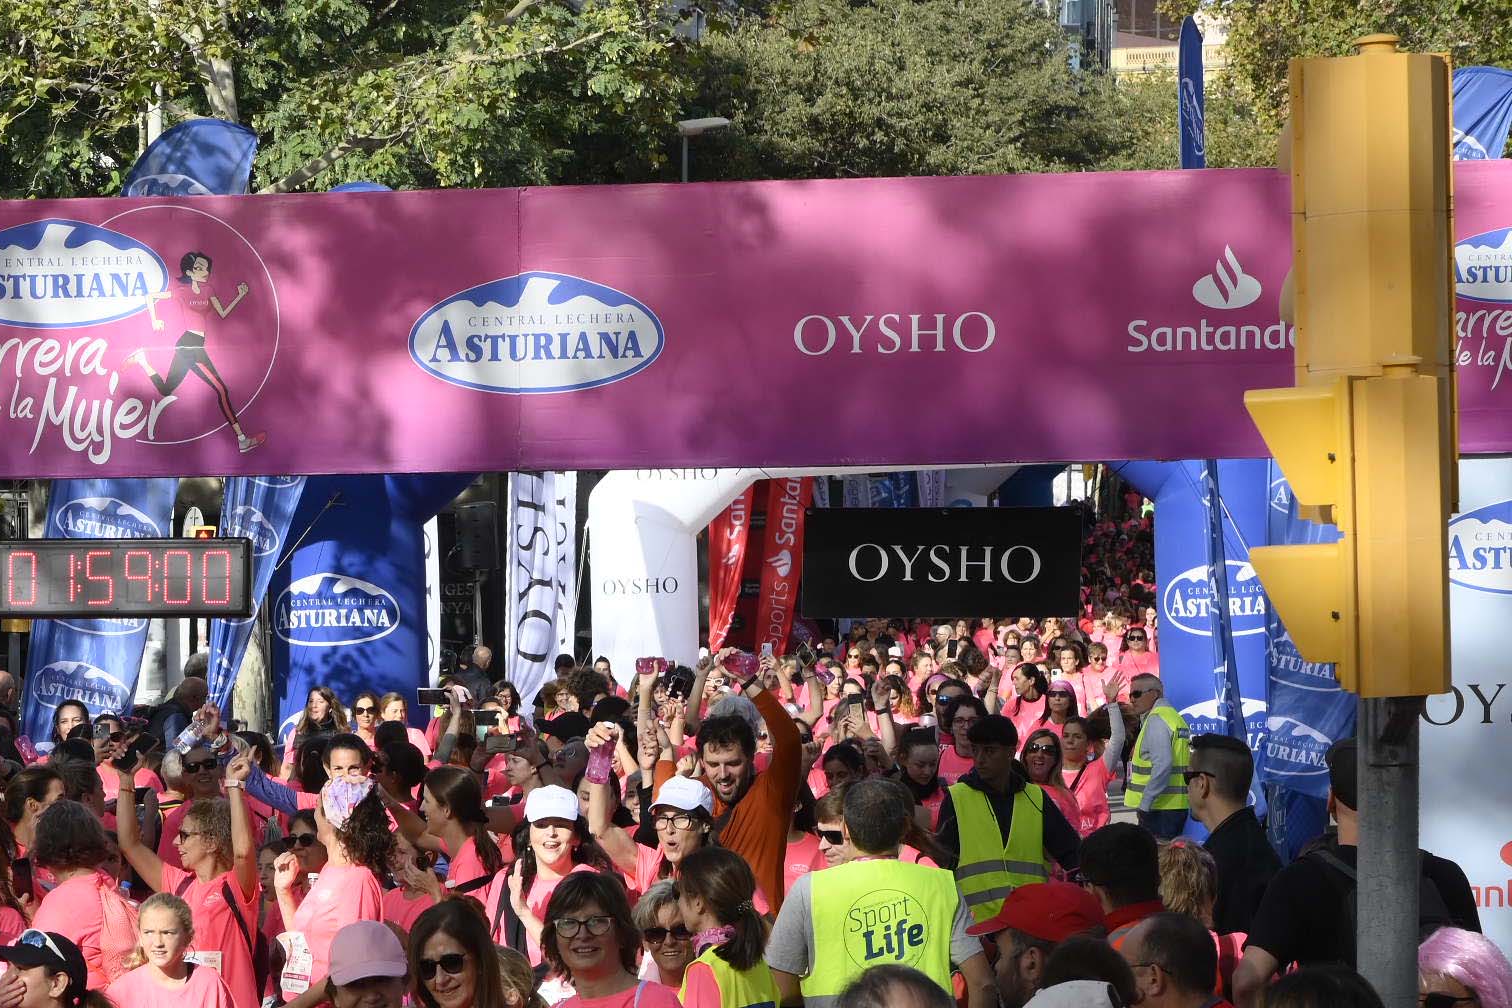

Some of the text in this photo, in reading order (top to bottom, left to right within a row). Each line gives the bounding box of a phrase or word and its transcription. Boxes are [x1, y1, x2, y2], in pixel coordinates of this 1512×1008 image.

[71, 254, 145, 267] LECHERA
[1455, 259, 1512, 285] ASTU
[1468, 254, 1512, 263] CENTRA
[468, 311, 637, 328] CENTRAL LECHERA
[794, 310, 996, 357] OYSHO
[1127, 319, 1294, 352] Santand
[1456, 309, 1512, 338] arre
[429, 319, 643, 364] ASTURIANA
[1478, 341, 1495, 366] la
[9, 381, 34, 419] la
[29, 374, 178, 465] Mujer
[726, 494, 745, 540] San
[776, 477, 802, 547] Santa
[7, 550, 232, 606] 01:59:00
[516, 472, 554, 663] OYSH
[848, 543, 1041, 583] OYSHO
[602, 576, 680, 596] OYSHO
[1171, 588, 1266, 617] ASTRIA
[279, 603, 390, 631] ASTURIANA
[37, 680, 123, 710] ASTURIANA
[1420, 683, 1512, 727] OY
[1267, 743, 1329, 767] URIANA
[849, 896, 911, 933] Sport
[862, 918, 924, 961] Life
